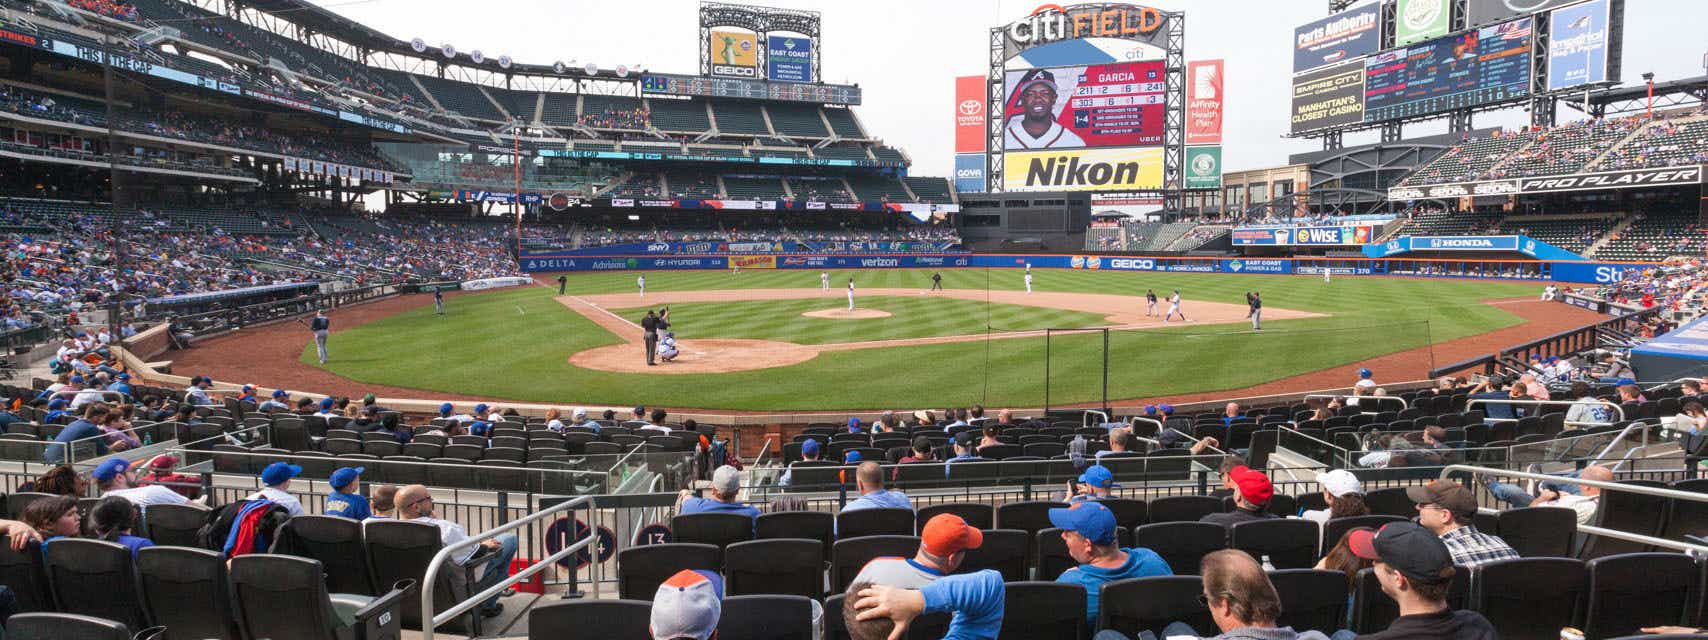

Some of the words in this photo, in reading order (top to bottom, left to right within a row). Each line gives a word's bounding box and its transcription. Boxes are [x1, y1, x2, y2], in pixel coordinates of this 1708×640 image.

[1011, 4, 1066, 42] citi
[1073, 7, 1161, 38] FIELD
[1297, 27, 1325, 45] Parts
[1325, 12, 1377, 37] Authority
[787, 50, 809, 58] COAST
[1125, 48, 1144, 60] citi
[76, 46, 100, 61] THIS
[133, 59, 153, 74] CAP
[714, 66, 755, 76] GEICO
[1098, 72, 1135, 82] GARCIA
[1145, 82, 1163, 92] .241
[1296, 80, 1333, 94] EMPIRE
[1335, 73, 1360, 85] CITY
[1190, 101, 1219, 110] Affinity
[1298, 95, 1356, 114] MANHATTAN'S
[1292, 109, 1328, 123] CLOSEST
[1329, 103, 1363, 117] CASINO
[1139, 135, 1161, 143] UBER
[478, 145, 531, 155] PORSCHE
[1025, 156, 1141, 187] Nikon
[1521, 177, 1577, 192] PRO
[1579, 168, 1699, 187] PLAYER
[1310, 229, 1339, 243] WISE
[1442, 238, 1493, 248] HONDA
[539, 260, 576, 268] DELTA
[861, 256, 898, 267] verizon
[1111, 259, 1153, 269] GEICO
